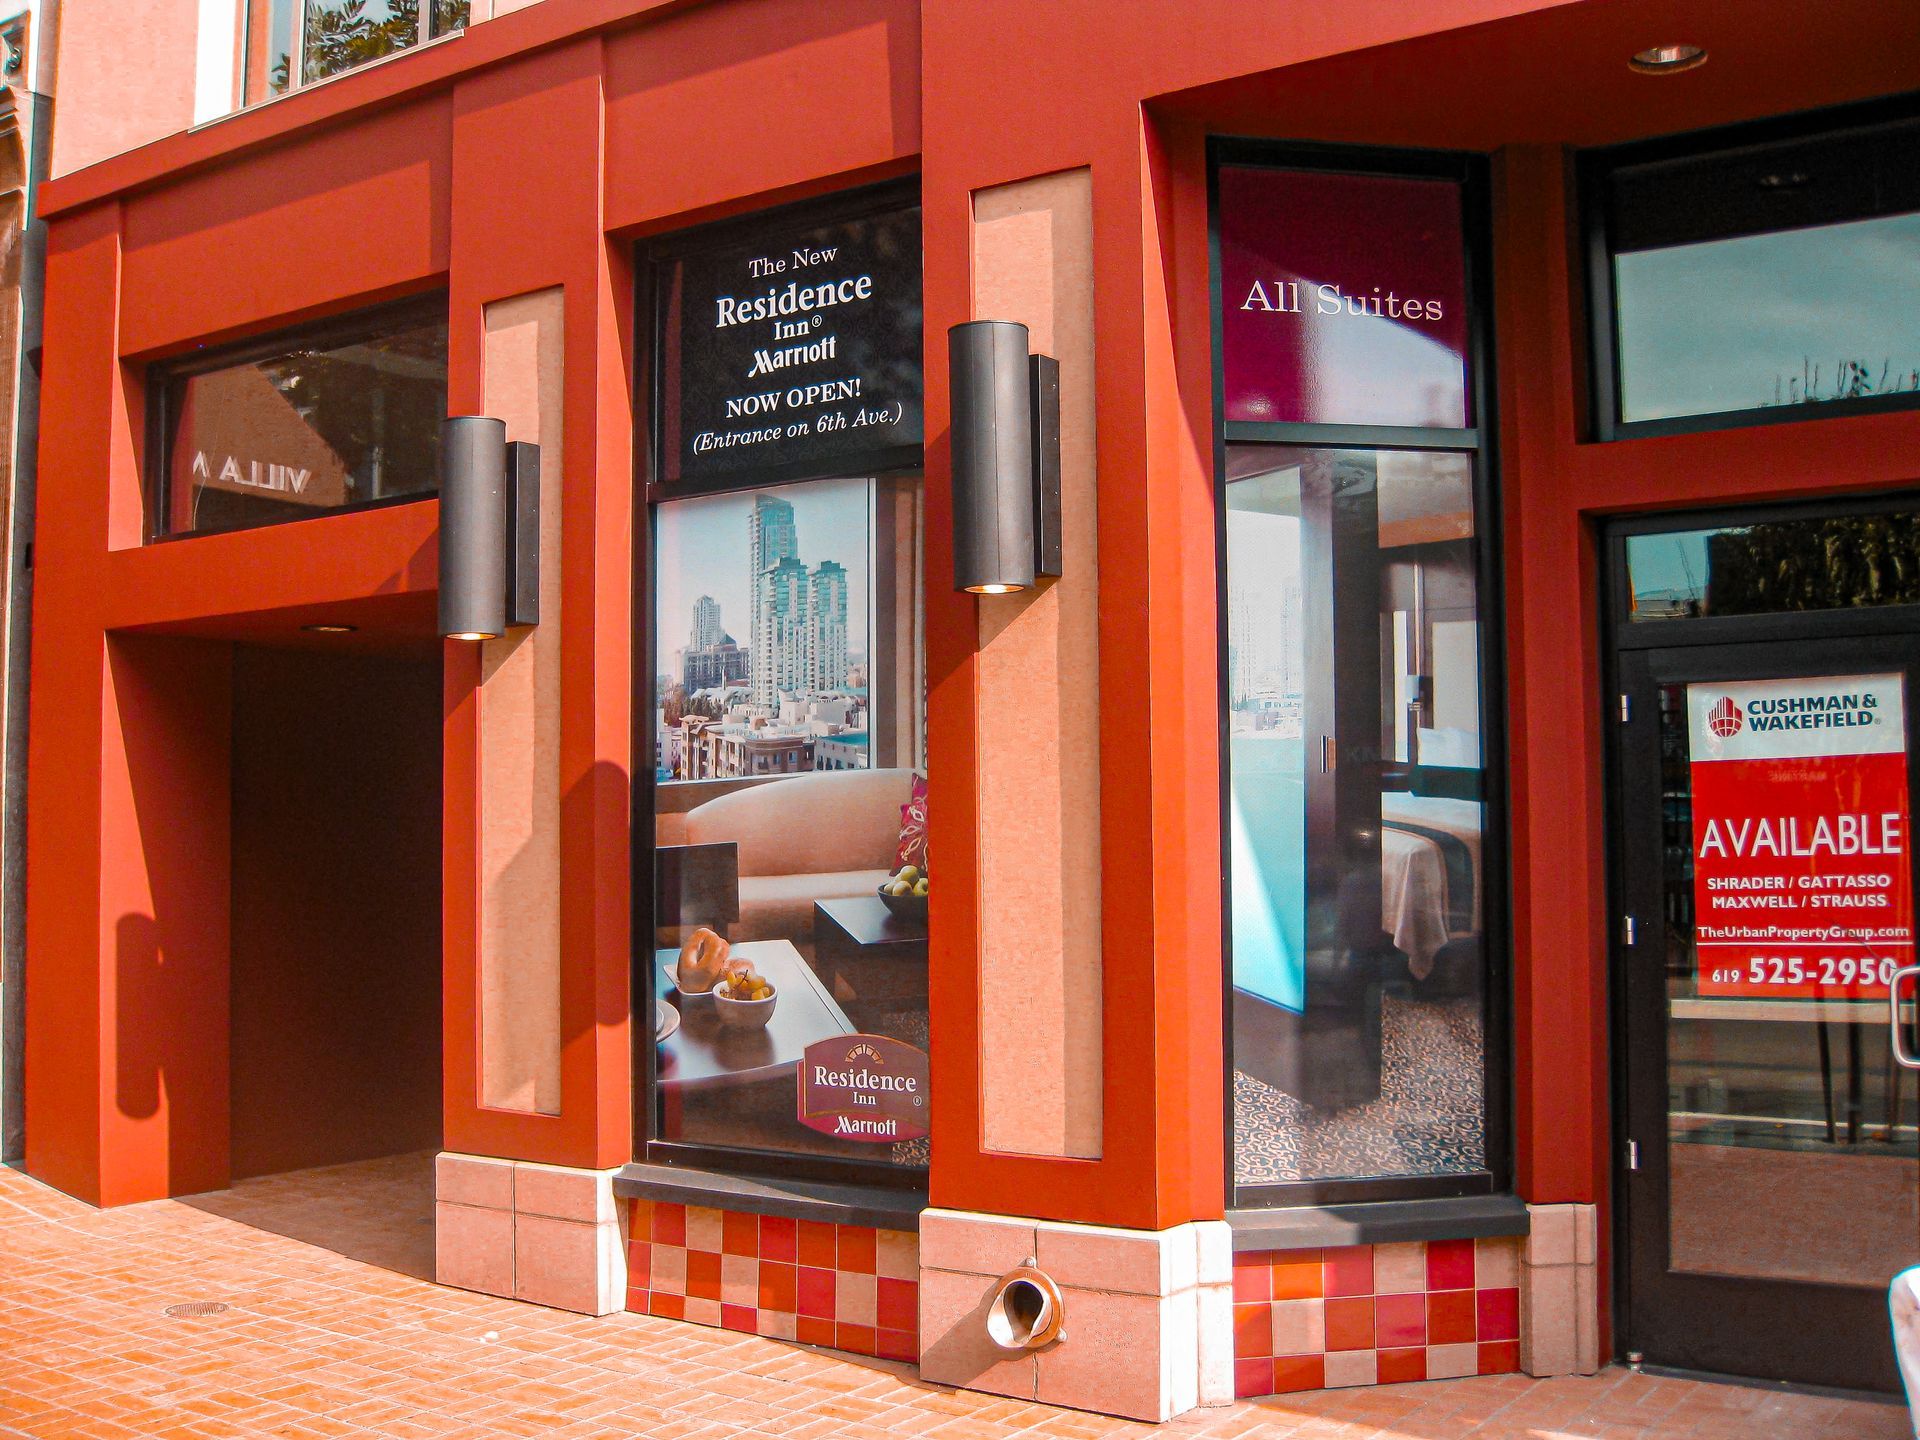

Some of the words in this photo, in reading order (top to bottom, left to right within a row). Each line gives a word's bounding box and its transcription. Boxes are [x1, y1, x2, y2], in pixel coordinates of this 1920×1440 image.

[749, 258, 786, 278] The
[792, 248, 838, 269] New
[716, 275, 872, 328] Residence
[1240, 280, 1302, 313] All
[1317, 284, 1443, 321] Suites
[748, 335, 836, 378] Marriott
[726, 392, 781, 419] NOW
[786, 378, 862, 408] OPEN!
[693, 427, 782, 455] (Entrance
[787, 421, 810, 438] on
[816, 412, 847, 433] 6th
[852, 402, 903, 428] Ave.)
[1747, 694, 1858, 715] CUSHMAN
[1862, 693, 1877, 708] &
[1699, 813, 1902, 858] AVAILABLE
[1707, 876, 1785, 890] SHRADER
[1798, 874, 1891, 889] GATTASSO
[1712, 896, 1797, 909] MAXWELL
[1811, 894, 1887, 908] STRAUSS
[1698, 926, 1910, 940] TheUrbanPropertyGroup.com
[1712, 969, 1740, 983] 619
[1749, 957, 1897, 985] 525-2950
[814, 1065, 917, 1092] Residence
[853, 1092, 876, 1105] Inn
[834, 1115, 897, 1136] Marriott
